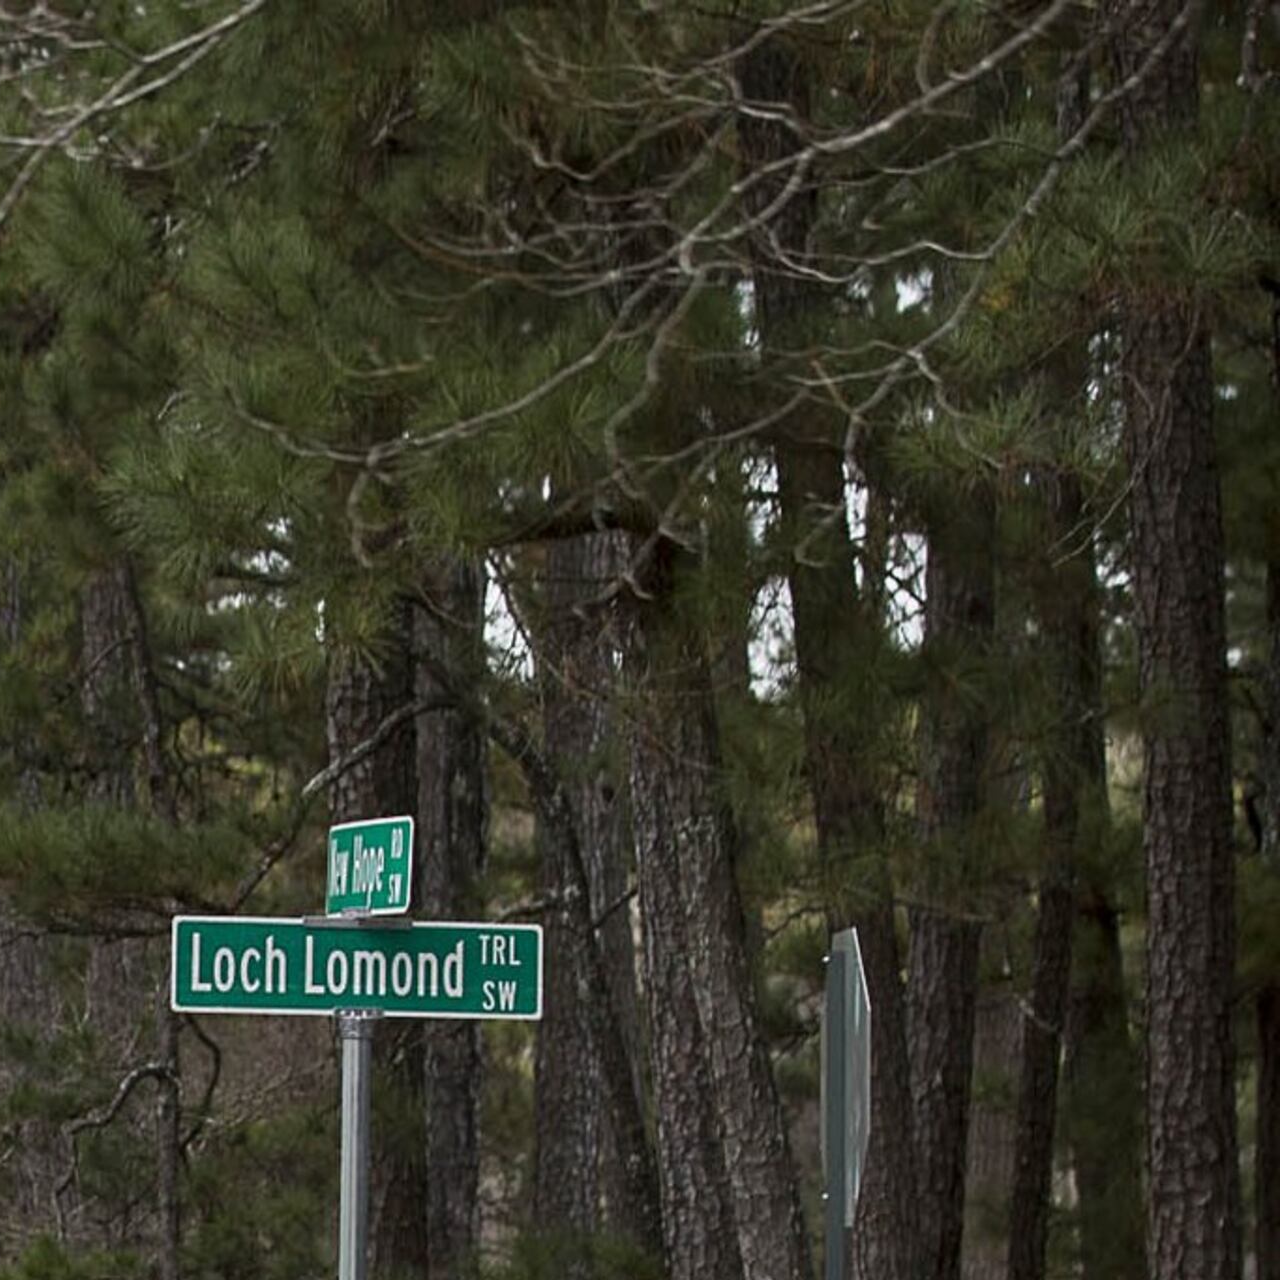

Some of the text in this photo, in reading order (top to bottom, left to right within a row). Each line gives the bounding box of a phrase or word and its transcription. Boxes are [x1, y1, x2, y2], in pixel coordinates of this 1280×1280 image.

[329, 834, 385, 909] New Hope
[388, 872, 402, 904] SW
[190, 932, 465, 998] Loch Lomond
[479, 934, 522, 966] TRL
[482, 980, 517, 1012] SW
